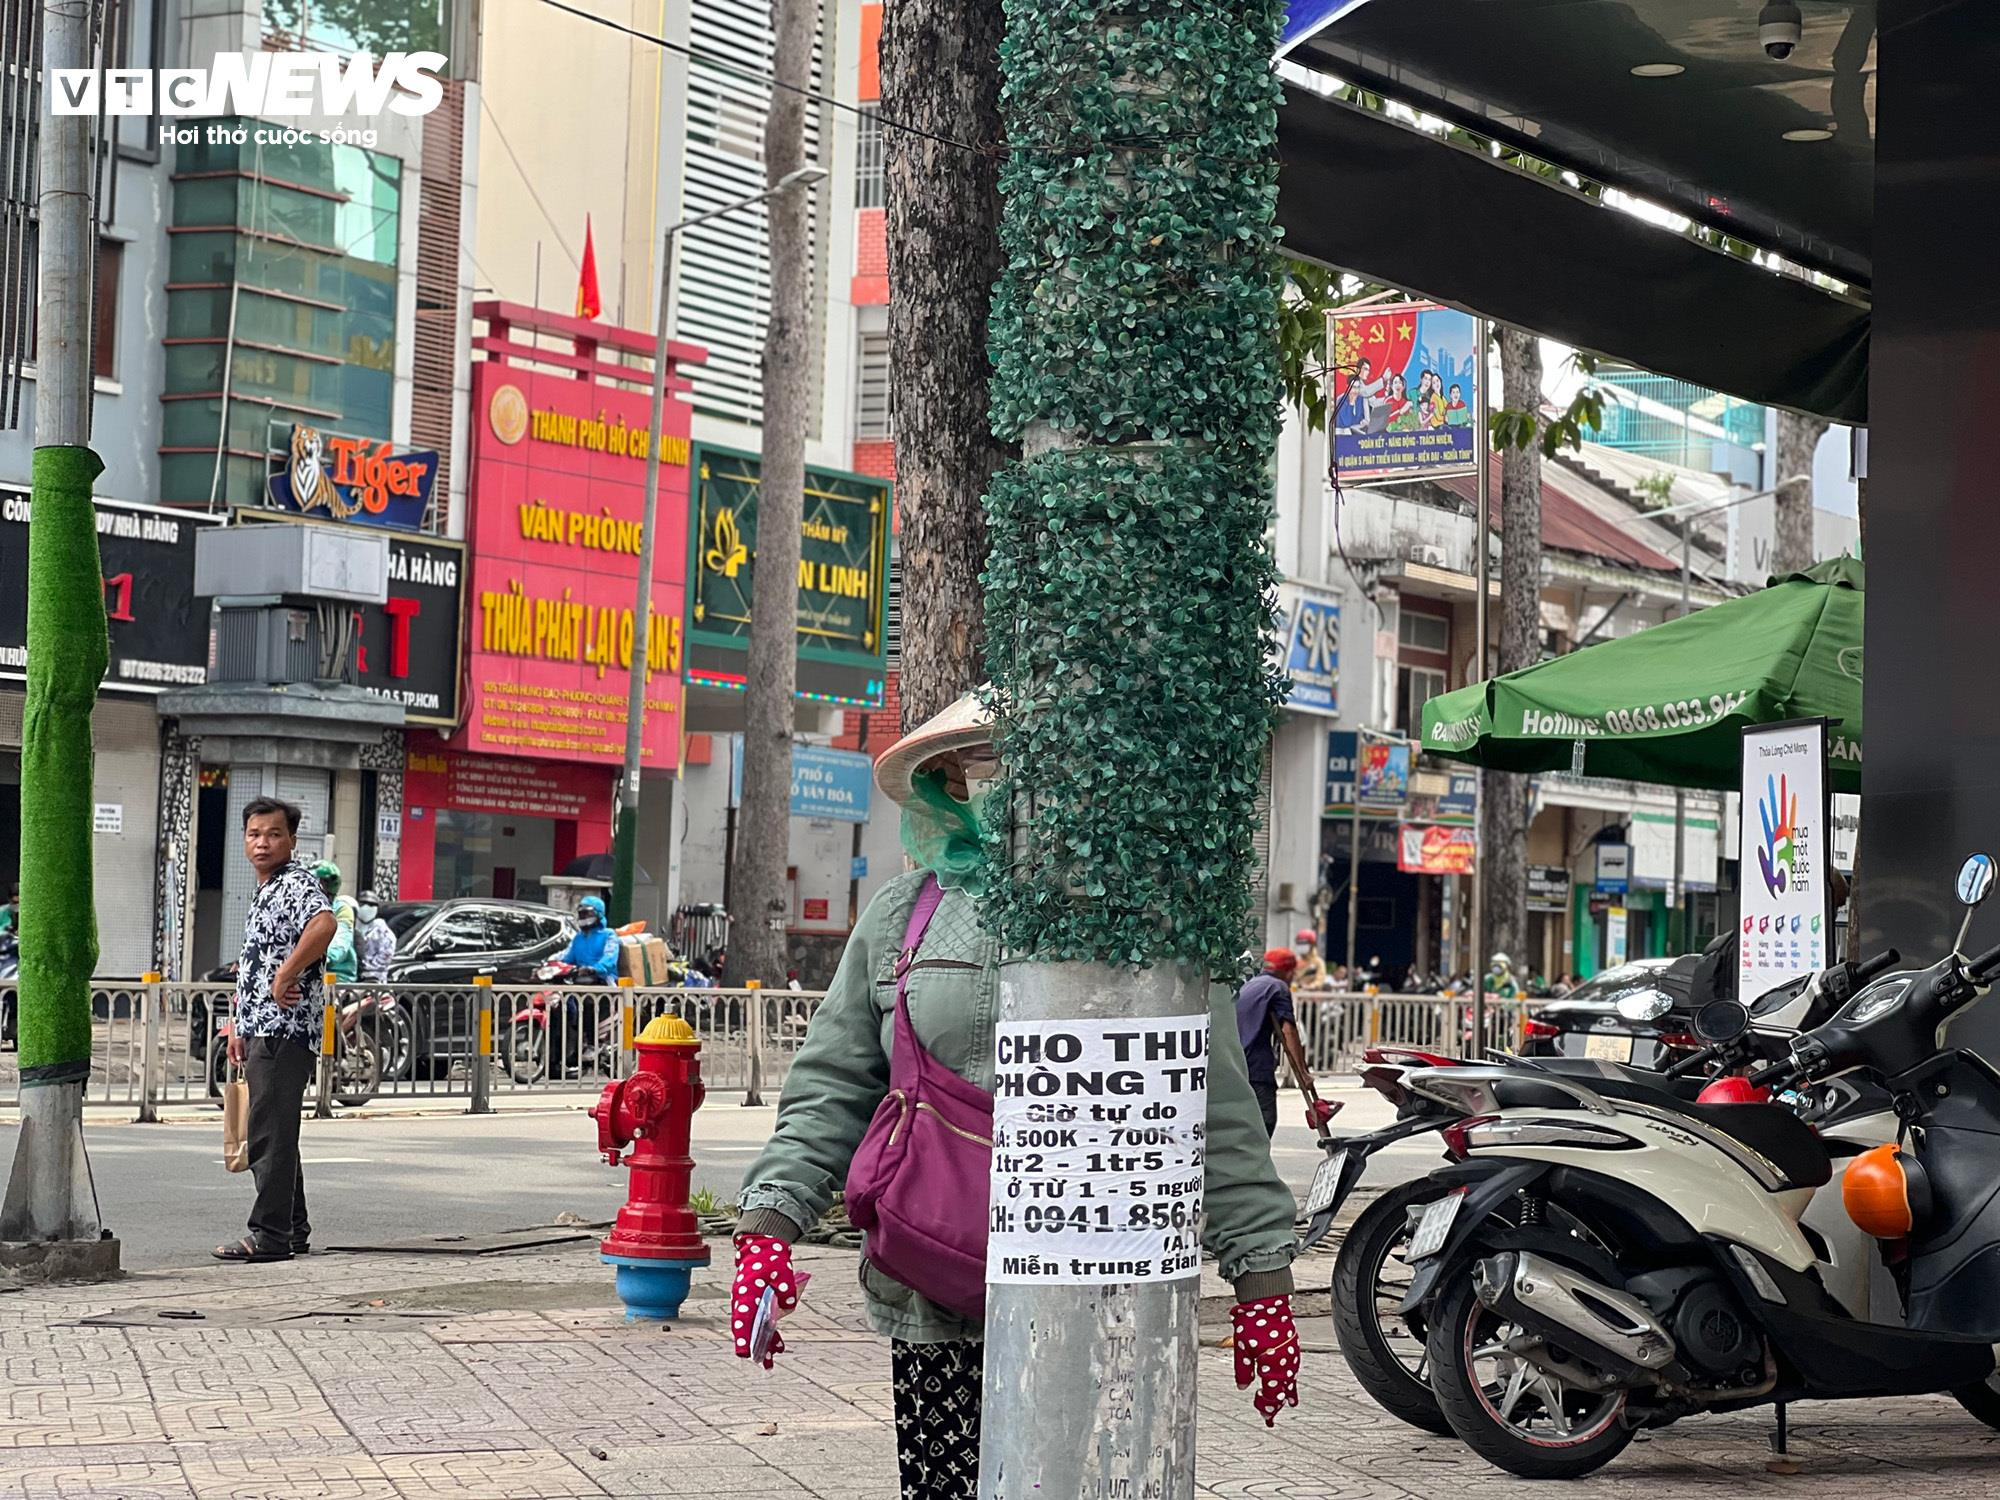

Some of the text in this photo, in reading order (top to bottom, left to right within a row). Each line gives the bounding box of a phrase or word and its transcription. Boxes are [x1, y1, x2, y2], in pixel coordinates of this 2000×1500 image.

[531, 406, 576, 446] THÀNH
[579, 409, 606, 451] PHỐ
[608, 413, 626, 455] HỒ
[329, 437, 428, 514] Tiger
[113, 512, 141, 539] NHÀ
[142, 514, 179, 544] HÀNG
[519, 499, 564, 543] VĂN
[410, 552, 457, 588] HÀNG
[819, 563, 868, 600] LINH
[481, 578, 681, 685] THỪA PHÁT LẠI QẬN 5
[1522, 709, 1605, 736] Hotline:
[380, 818, 399, 833] T&T
[1792, 826, 1808, 839] mua
[998, 1033, 1083, 1064] CHO
[994, 1066, 1145, 1097] PHÒNG
[1026, 1102, 1178, 1125] Giờ tự do
[1016, 1129, 1078, 1148] 500K
[1108, 1125, 1175, 1146] 700K
[996, 1153, 1043, 1173] 1tr2
[1086, 1151, 1163, 1172] 1tr5
[1029, 1178, 1068, 1198] TỪ
[1079, 1182, 1095, 1198] 1
[1129, 1180, 1147, 1197] 5
[1157, 1175, 1202, 1198] người
[1003, 1253, 1197, 1277] Miễn trung gian
